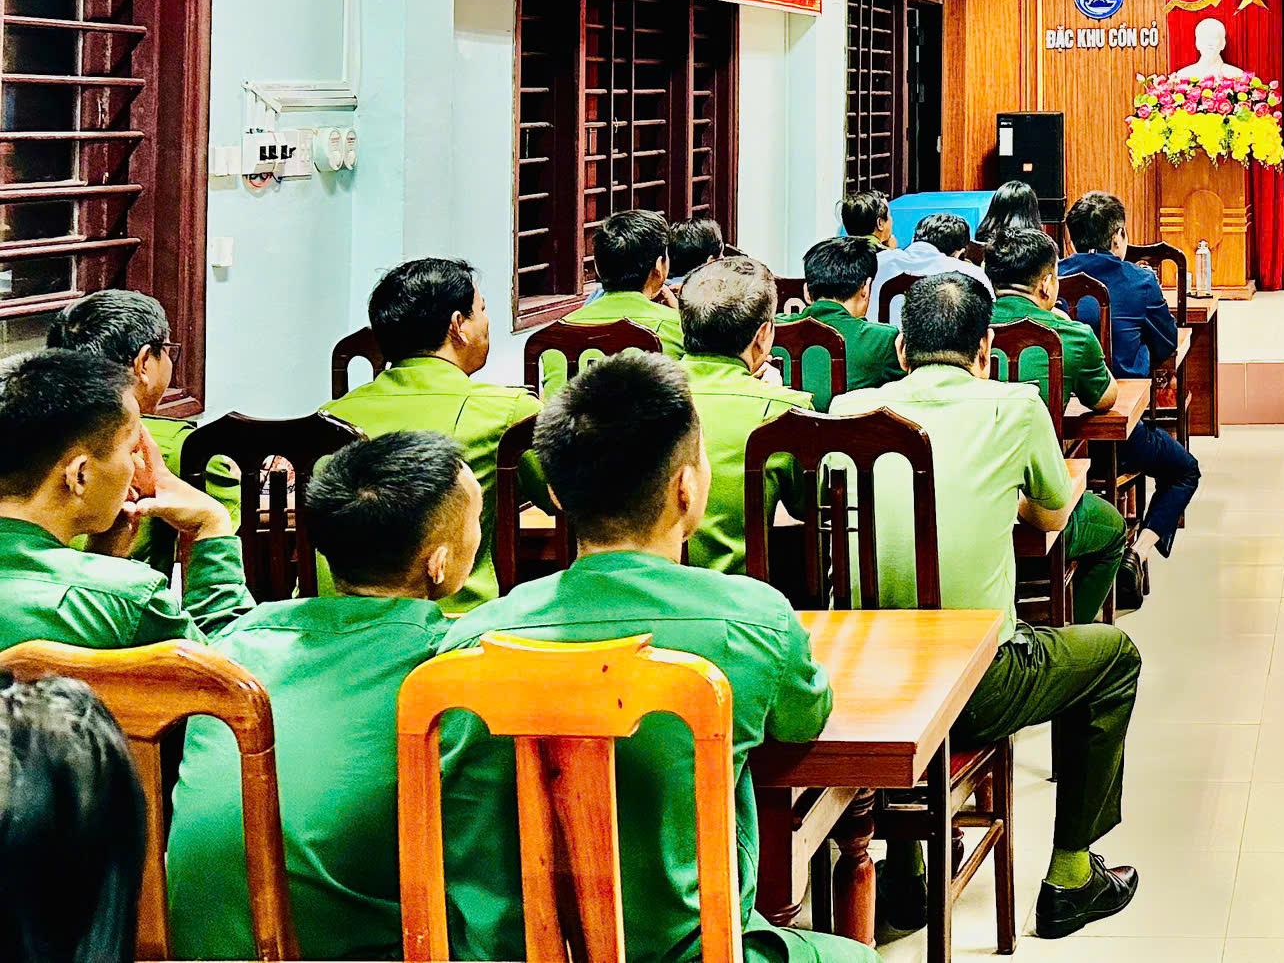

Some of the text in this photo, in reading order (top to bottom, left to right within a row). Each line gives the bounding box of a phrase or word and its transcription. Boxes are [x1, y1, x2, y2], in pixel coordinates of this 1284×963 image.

[1045, 20, 1159, 53] ĐẶC KHU CỒN CỎ
